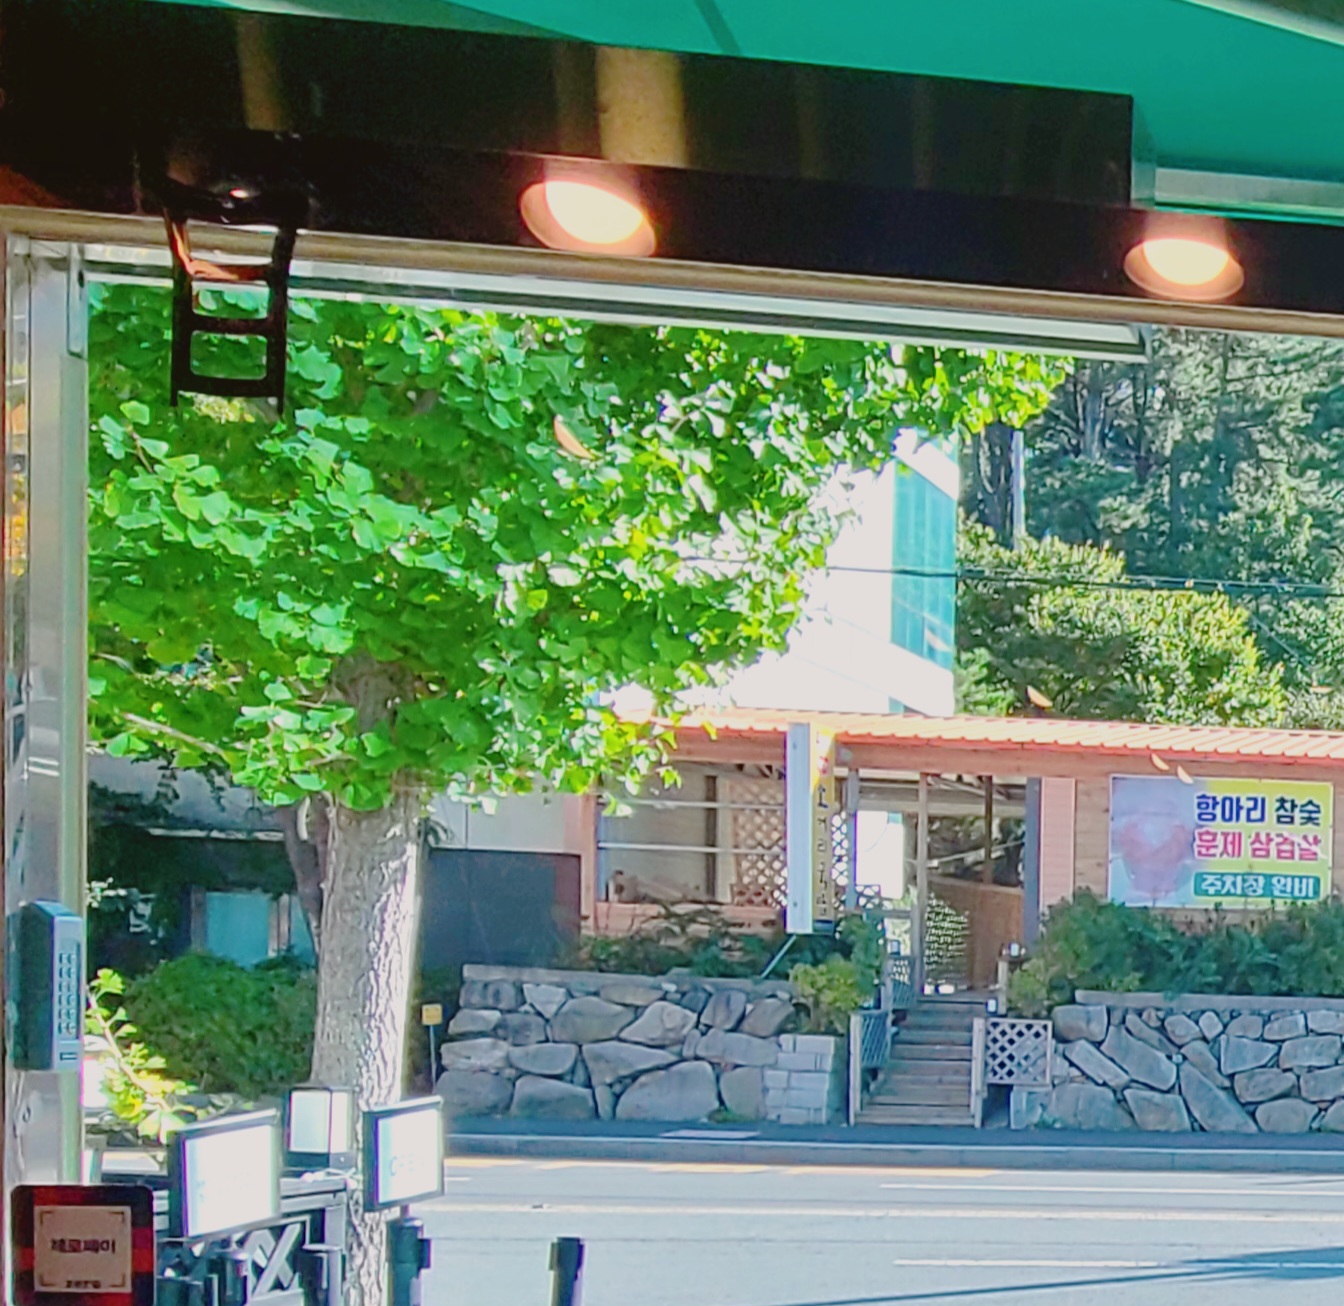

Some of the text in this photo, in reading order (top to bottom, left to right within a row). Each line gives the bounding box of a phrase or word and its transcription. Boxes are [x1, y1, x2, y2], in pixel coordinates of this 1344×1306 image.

[1196, 793, 1322, 827] 항아리 참숯
[1196, 829, 1322, 861] 훈제 삼겹살
[1201, 873, 1315, 899] 주차장 완비
